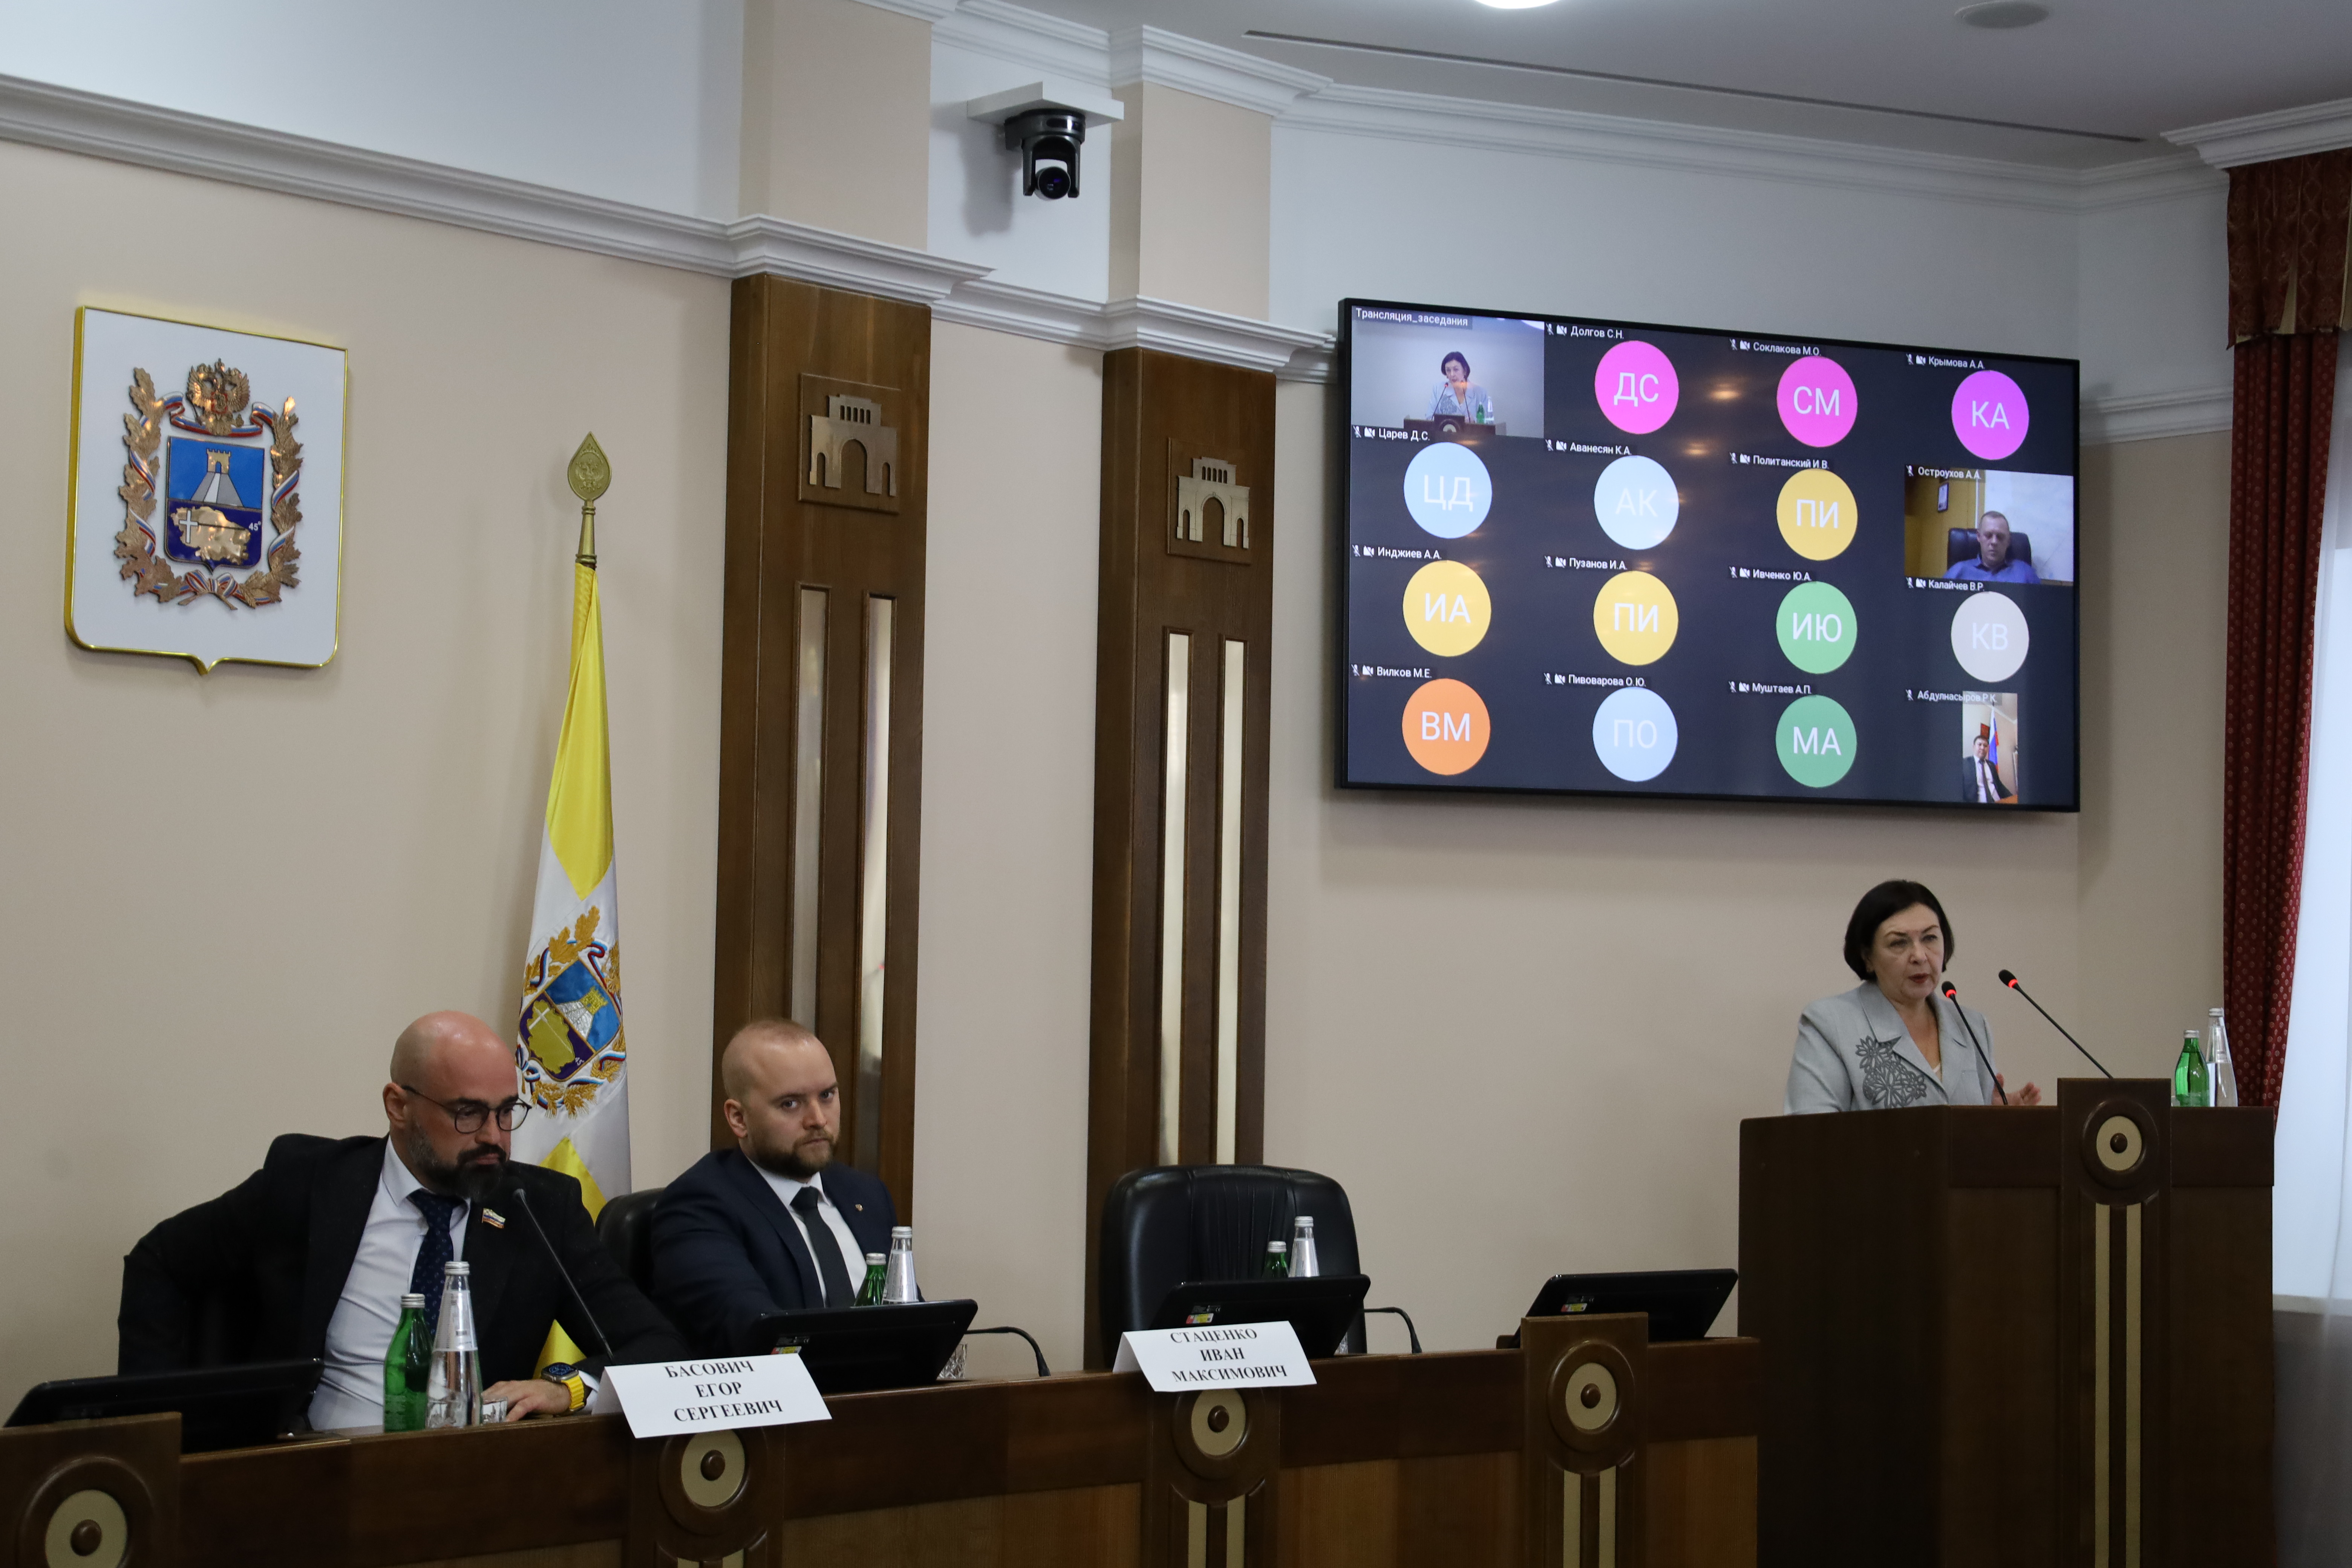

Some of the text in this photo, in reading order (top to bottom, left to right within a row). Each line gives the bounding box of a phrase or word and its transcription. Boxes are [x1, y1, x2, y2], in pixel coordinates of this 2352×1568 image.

[1355, 308, 1468, 326] Трансляция_заседания
[1570, 326, 1624, 339] Долгов С.Н.
[1753, 342, 1821, 356] Соклакова М.О.
[1929, 356, 1985, 369] Крымова А.А.
[1614, 372, 1659, 407] ДС
[1793, 386, 1839, 416] СМ
[1972, 400, 2010, 429] КА
[1379, 428, 1430, 442] Царев Д.С.
[1570, 442, 1632, 455] Аванесян К.А.
[1753, 455, 1829, 469] Политанский И.В.
[1918, 467, 1981, 479] Остроухов А.А.
[1424, 475, 1473, 512] ЦД
[1615, 488, 1658, 517] АК
[1796, 499, 1838, 528] ПИ
[1378, 547, 1442, 559] Инджиев А.А.
[1569, 557, 1628, 570] Пузанов И.А.
[1753, 569, 1812, 581] Ивченко Ю.А.
[1929, 580, 1985, 591] Калайчев В.Р.
[1425, 593, 1471, 623] ИА
[1614, 603, 1658, 632] ПИ
[1793, 612, 1842, 642] ИЮ
[1972, 623, 2008, 650] КВ
[1377, 666, 1432, 678] Вилков М.Е.
[1568, 674, 1646, 687] Пивоварова О.Ю.
[1752, 683, 1811, 694] Муштаев А.П.
[1917, 690, 1981, 702] Абдулнасыров
[1422, 711, 1470, 741] ВМ
[1614, 719, 1657, 749] ПО
[1793, 726, 1841, 755] МА
[1170, 1328, 1257, 1343] СТАЦЕНКО
[1199, 1348, 1245, 1361] ИВАН
[664, 1360, 755, 1378] БАСОВИЧ
[1171, 1365, 1288, 1382] МАКСИМОВИЧ
[694, 1381, 741, 1398] ЕГОР
[674, 1400, 784, 1422] СЕРГЕЕВИЧ
